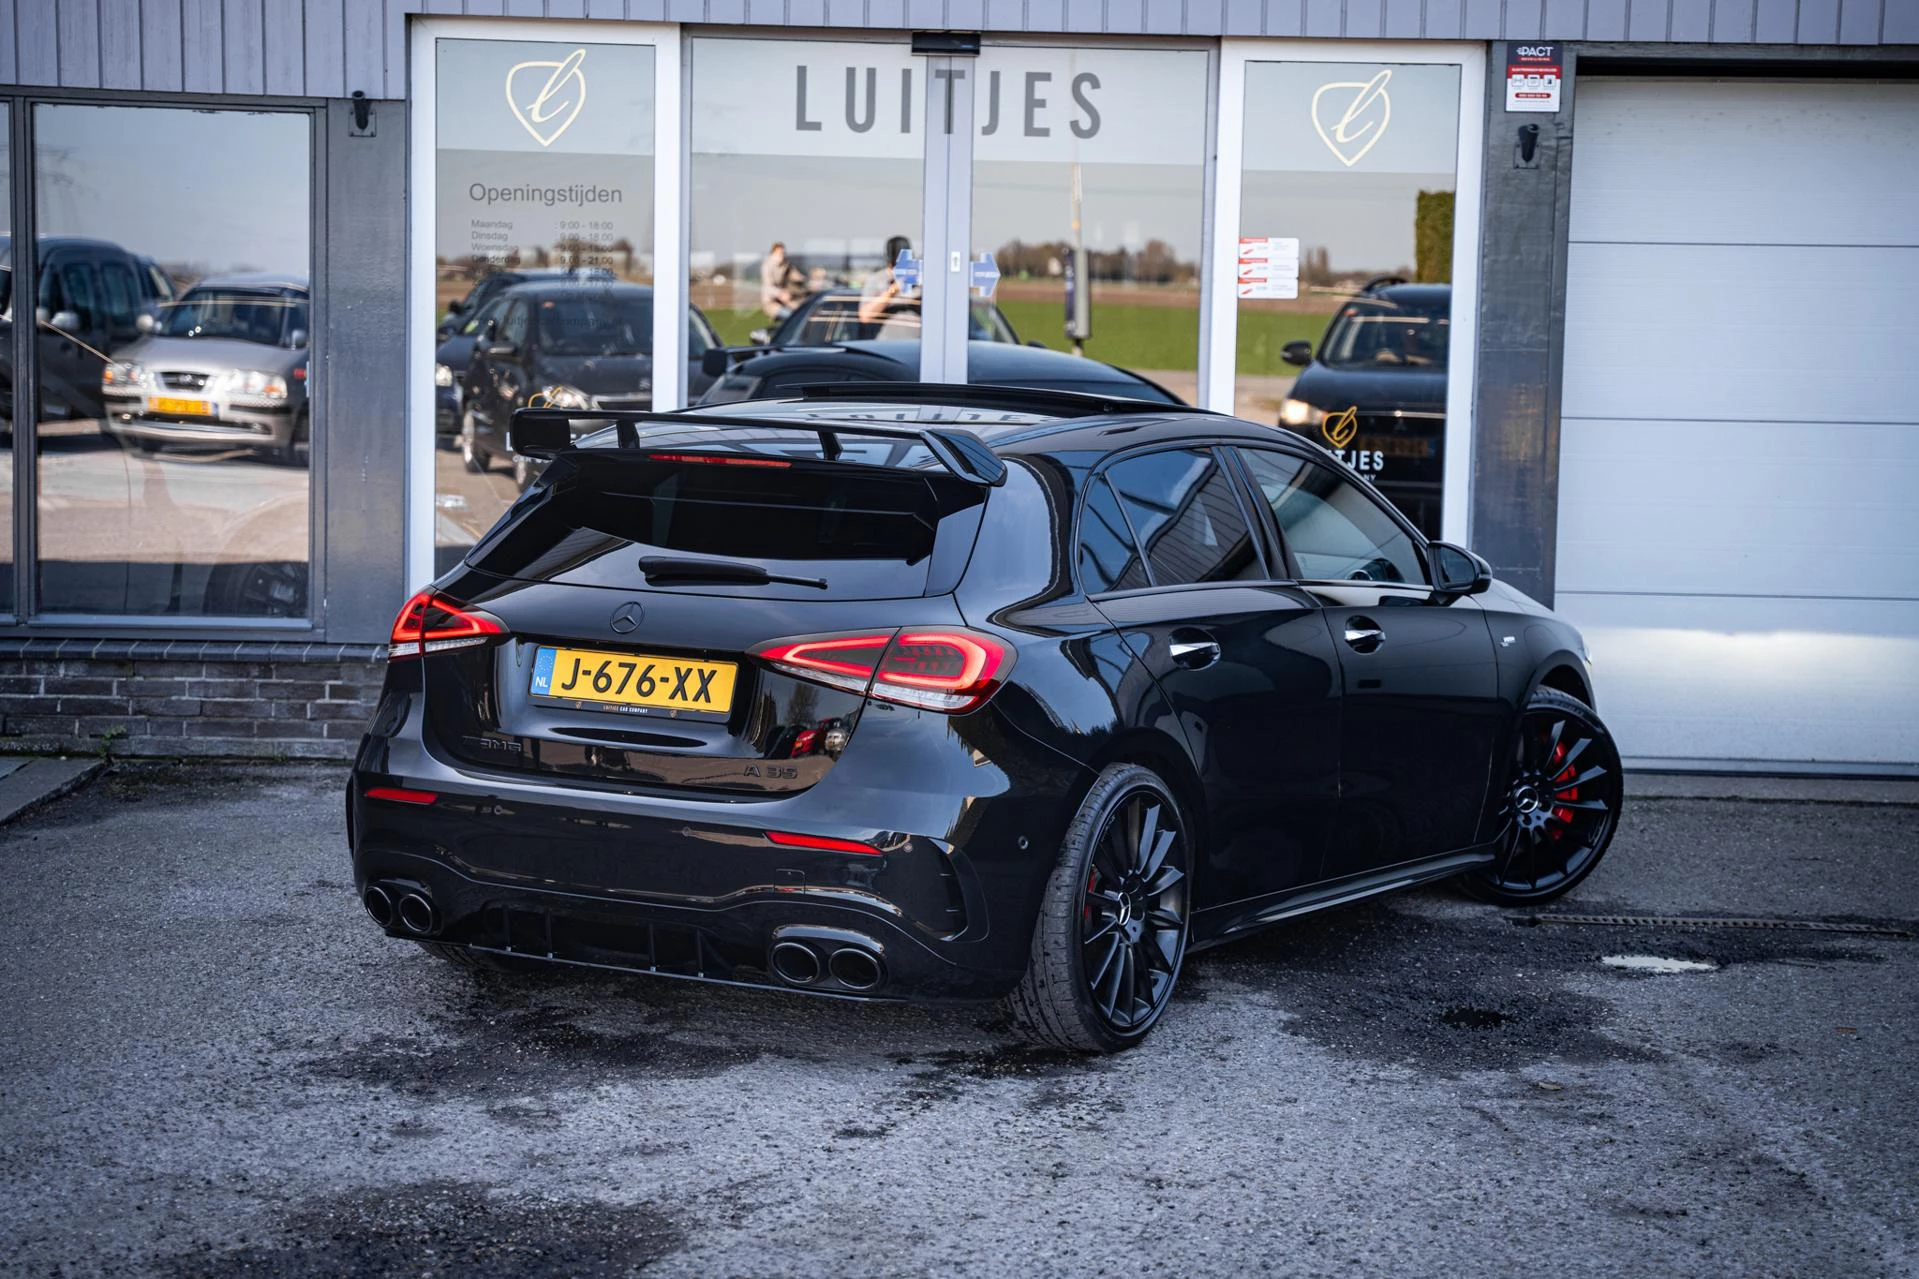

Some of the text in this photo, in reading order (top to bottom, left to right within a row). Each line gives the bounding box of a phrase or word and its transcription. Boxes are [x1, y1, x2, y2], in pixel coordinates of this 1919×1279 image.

[796, 65, 1102, 139] LUITJES
[469, 183, 622, 206] Openingstijden
[471, 219, 513, 230] Maandag
[471, 231, 508, 241] Dinsdag
[1329, 450, 1384, 471] TJES
[535, 676, 548, 688] NL
[561, 658, 717, 703] J-676-XX
[743, 764, 798, 779] A 35
